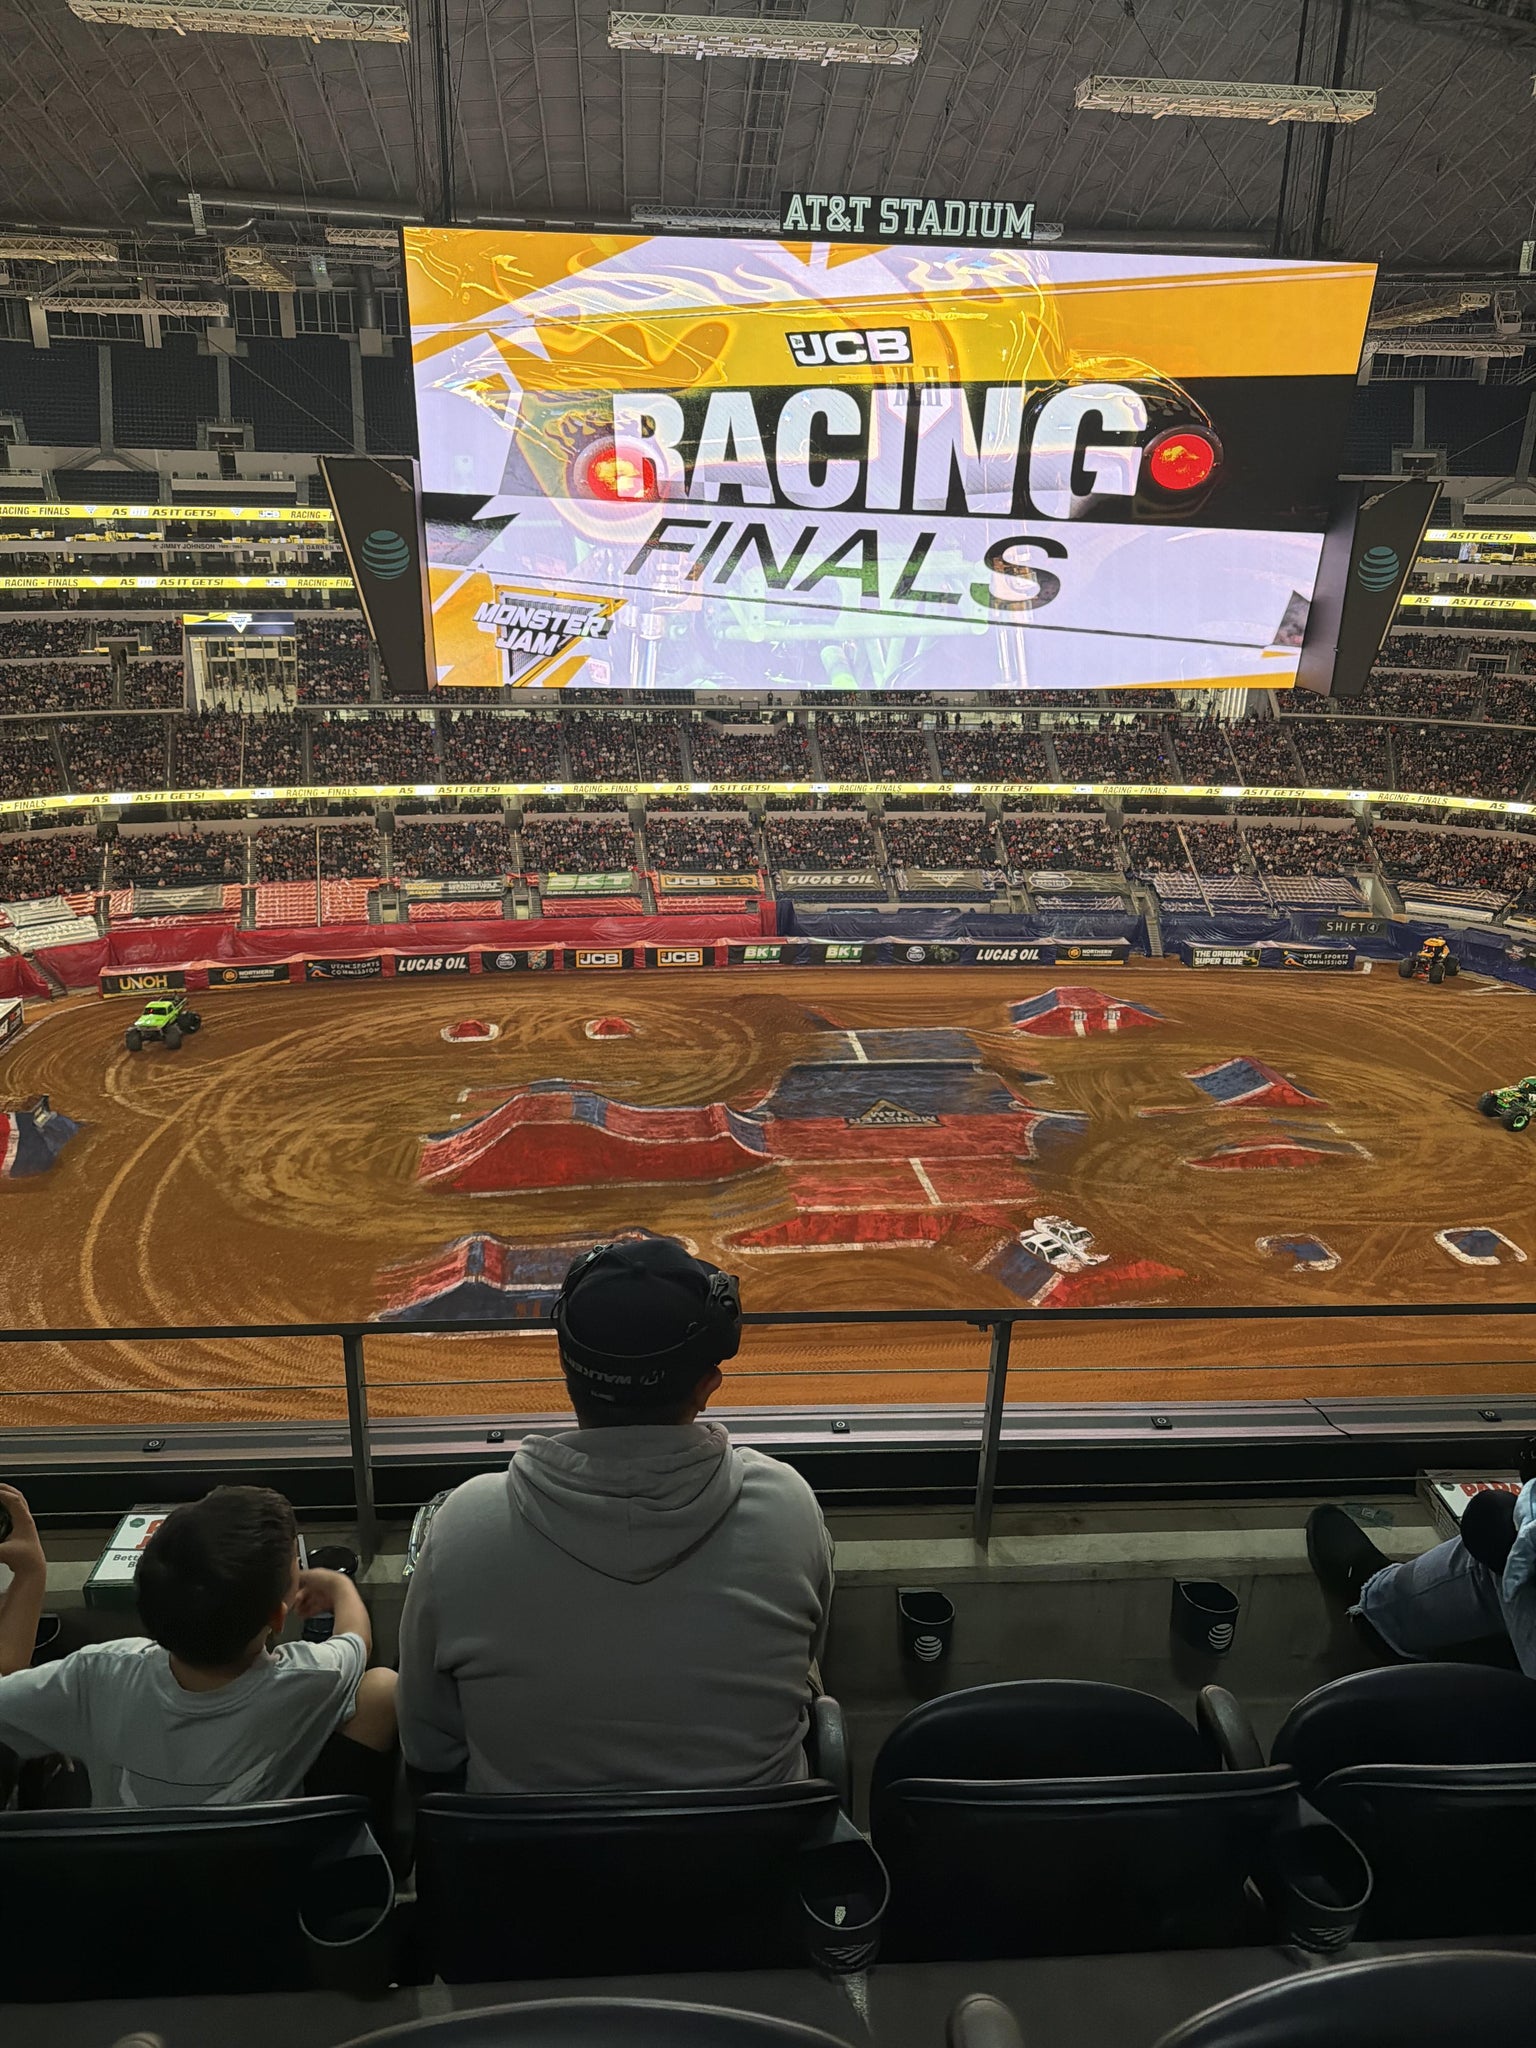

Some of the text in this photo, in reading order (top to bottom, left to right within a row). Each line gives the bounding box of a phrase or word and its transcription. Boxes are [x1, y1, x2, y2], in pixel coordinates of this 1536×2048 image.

[783, 194, 1035, 239] AT&T STADIUM
[789, 330, 911, 364] JCB
[613, 383, 1148, 520] RACING
[39, 507, 70, 516] FINALS
[112, 508, 127, 516] AS
[152, 508, 168, 516] AS
[169, 508, 182, 516] IT
[184, 509, 217, 517] GETS!
[290, 511, 321, 519] RACING
[1449, 532, 1513, 541] AS IT GETS!
[624, 517, 1069, 609] FINALS
[4, 578, 78, 587] RACING FINALS
[120, 578, 136, 586] AS
[160, 578, 175, 586] AS
[192, 578, 224, 586] GETS!
[297, 578, 327, 587] RACING
[1414, 596, 1516, 608] AS AS IT GETS!
[473, 602, 607, 639] MONSTER
[496, 628, 560, 656] JAM
[286, 787, 358, 798] RACING FINALS
[398, 786, 414, 795] AS
[437, 786, 453, 795] AS
[469, 785, 501, 794] GETS!
[573, 784, 639, 793] RACING FINALS
[675, 784, 690, 792] AS
[712, 784, 726, 792] AS
[740, 784, 771, 792] GETS!
[839, 784, 902, 793] RACING FINALS
[938, 784, 952, 792] AS
[974, 785, 988, 793] AS
[1002, 785, 1033, 793] GETS!
[1102, 785, 1168, 795] RACING FINALS
[1205, 787, 1220, 795] AS
[1242, 788, 1257, 796] AS
[1273, 788, 1305, 797] GETS!
[92, 791, 205, 804] AS AS IT GETS!
[1378, 792, 1448, 806] RACING FINALS
[14, 799, 47, 810] FINALS
[1488, 801, 1505, 810] AS
[549, 874, 630, 887] BKT
[666, 877, 717, 886] JCB
[787, 874, 875, 885] LUCAS OIL
[744, 947, 780, 957] BKT
[827, 946, 862, 957] BKT
[976, 948, 1040, 961] LUCAS OIL
[1195, 950, 1248, 958] THE ORIGINAL
[580, 952, 619, 965] JCB
[661, 951, 699, 964] JCB
[1195, 957, 1244, 965] SUPER GLUE
[398, 956, 469, 972] LUCAS OIL
[119, 975, 169, 991] UNOH
